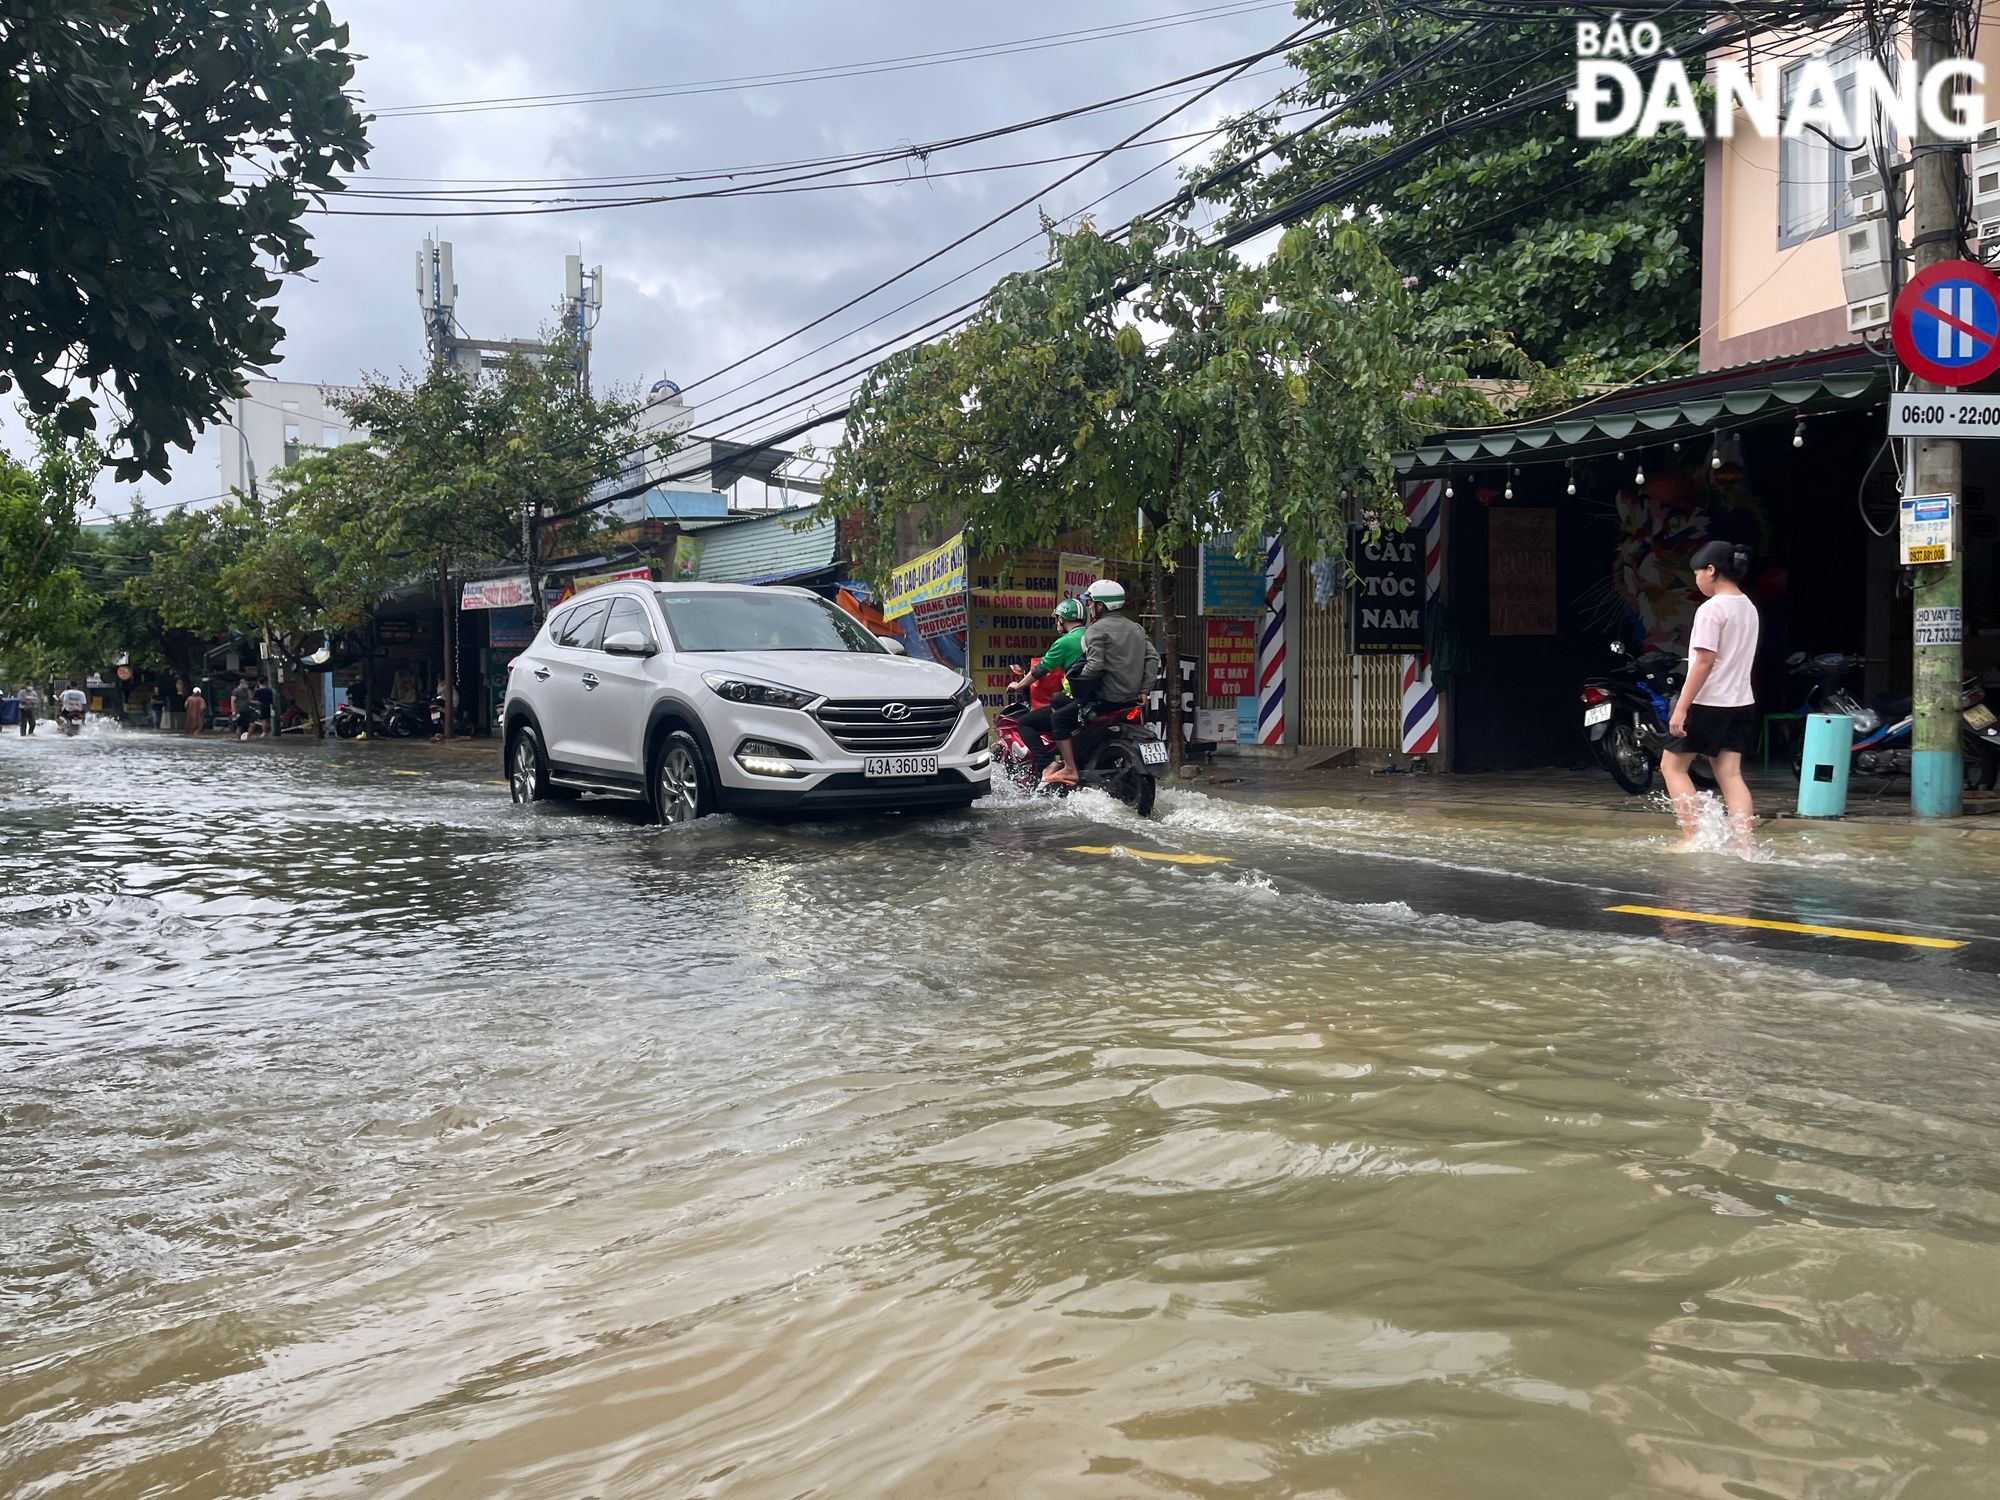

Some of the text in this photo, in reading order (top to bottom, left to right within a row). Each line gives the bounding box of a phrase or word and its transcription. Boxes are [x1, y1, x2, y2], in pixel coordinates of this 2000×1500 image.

[1902, 405, 1945, 424] 06:00
[1958, 406, 2000, 426] 22:00
[1364, 532, 1417, 563] CẮT
[1364, 571, 1416, 598] TÓC
[972, 595, 990, 608] THI
[992, 615, 1057, 630] PHOTOCOP
[1361, 608, 1420, 630] NAM
[1931, 609, 1948, 622] VAY
[988, 635, 1001, 649] IN
[1005, 635, 1037, 649] CARD
[1213, 667, 1226, 680] XE
[867, 756, 937, 775] 43A-360.99
